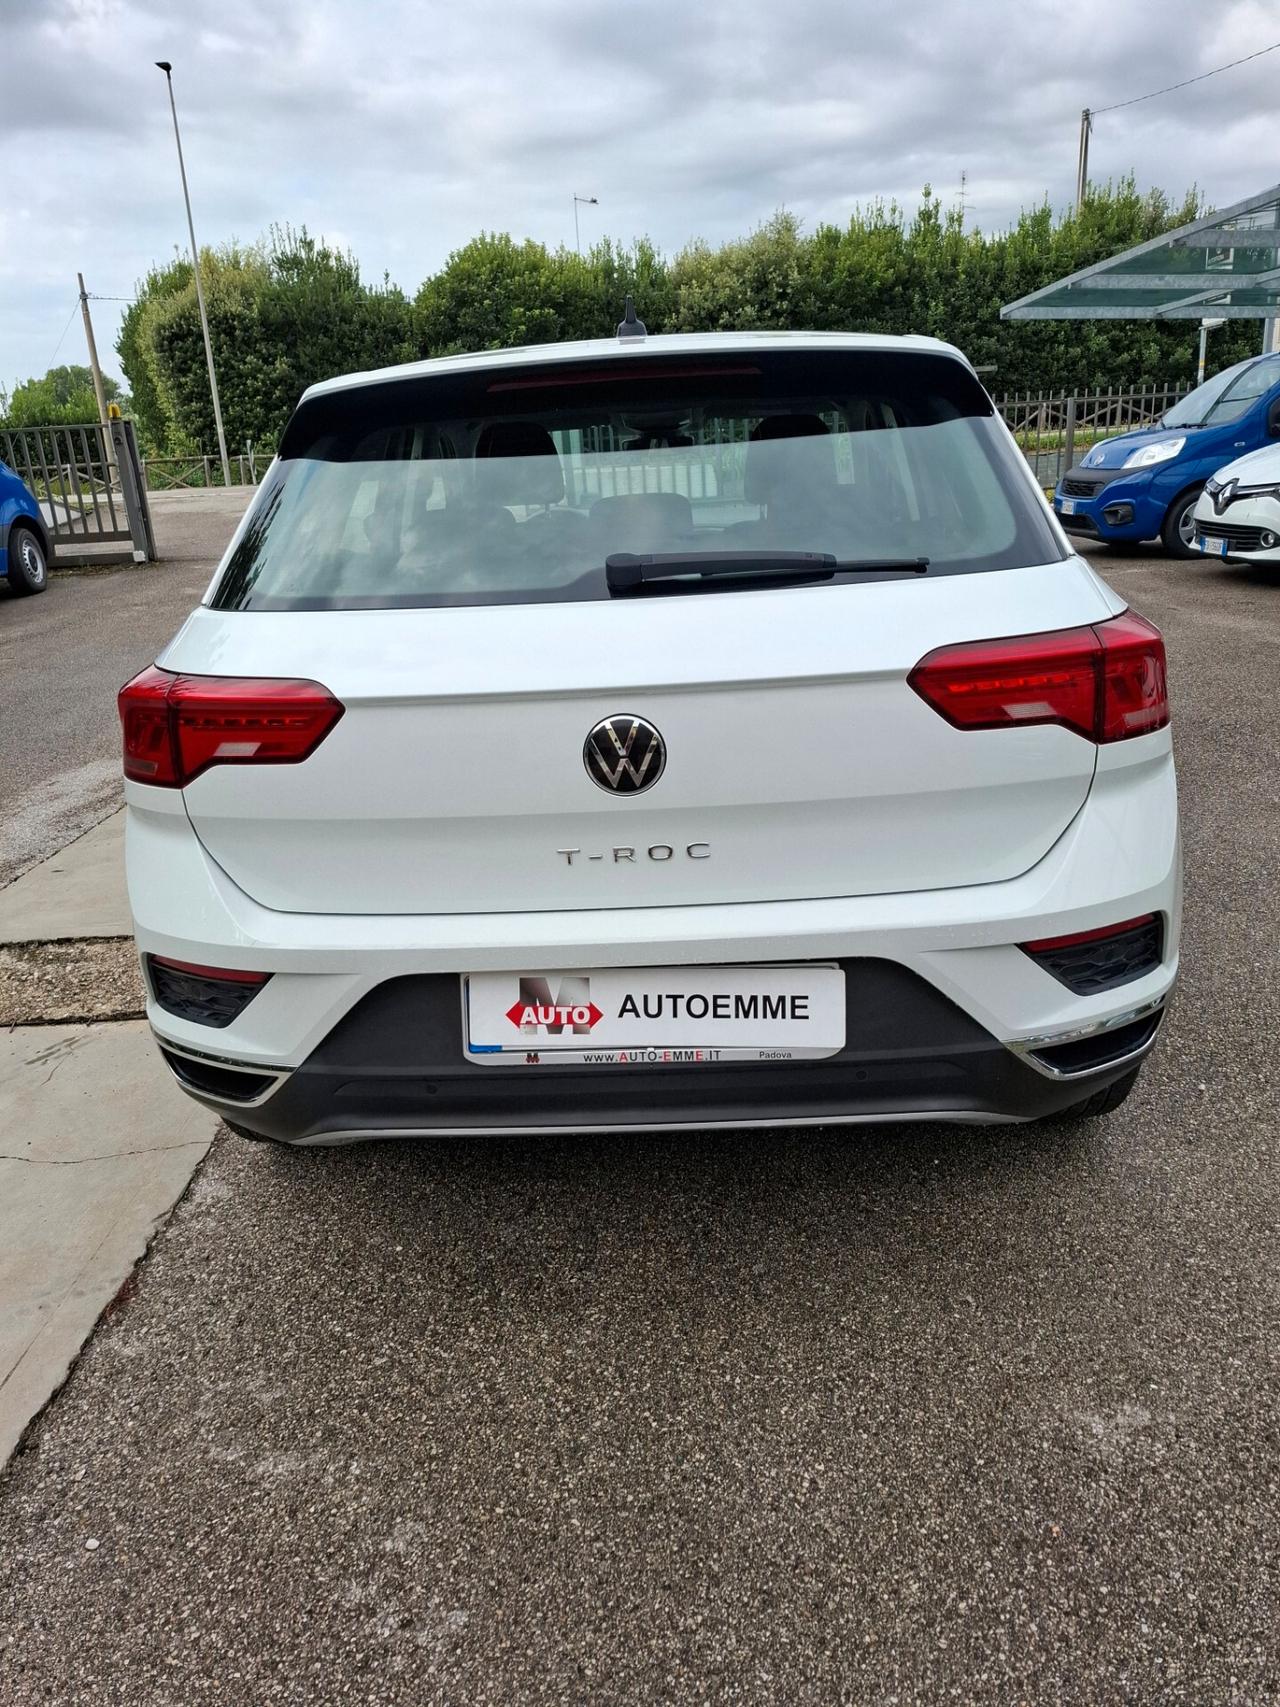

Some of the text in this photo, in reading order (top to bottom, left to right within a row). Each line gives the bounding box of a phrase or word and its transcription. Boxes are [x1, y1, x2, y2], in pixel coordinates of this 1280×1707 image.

[556, 841, 711, 866] T-ROC
[519, 1006, 591, 1025] AUTO
[617, 994, 810, 1020] AUTOEMME
[583, 1050, 721, 1063] www.AUTO-EMME.IT
[758, 1050, 792, 1060] Padova
